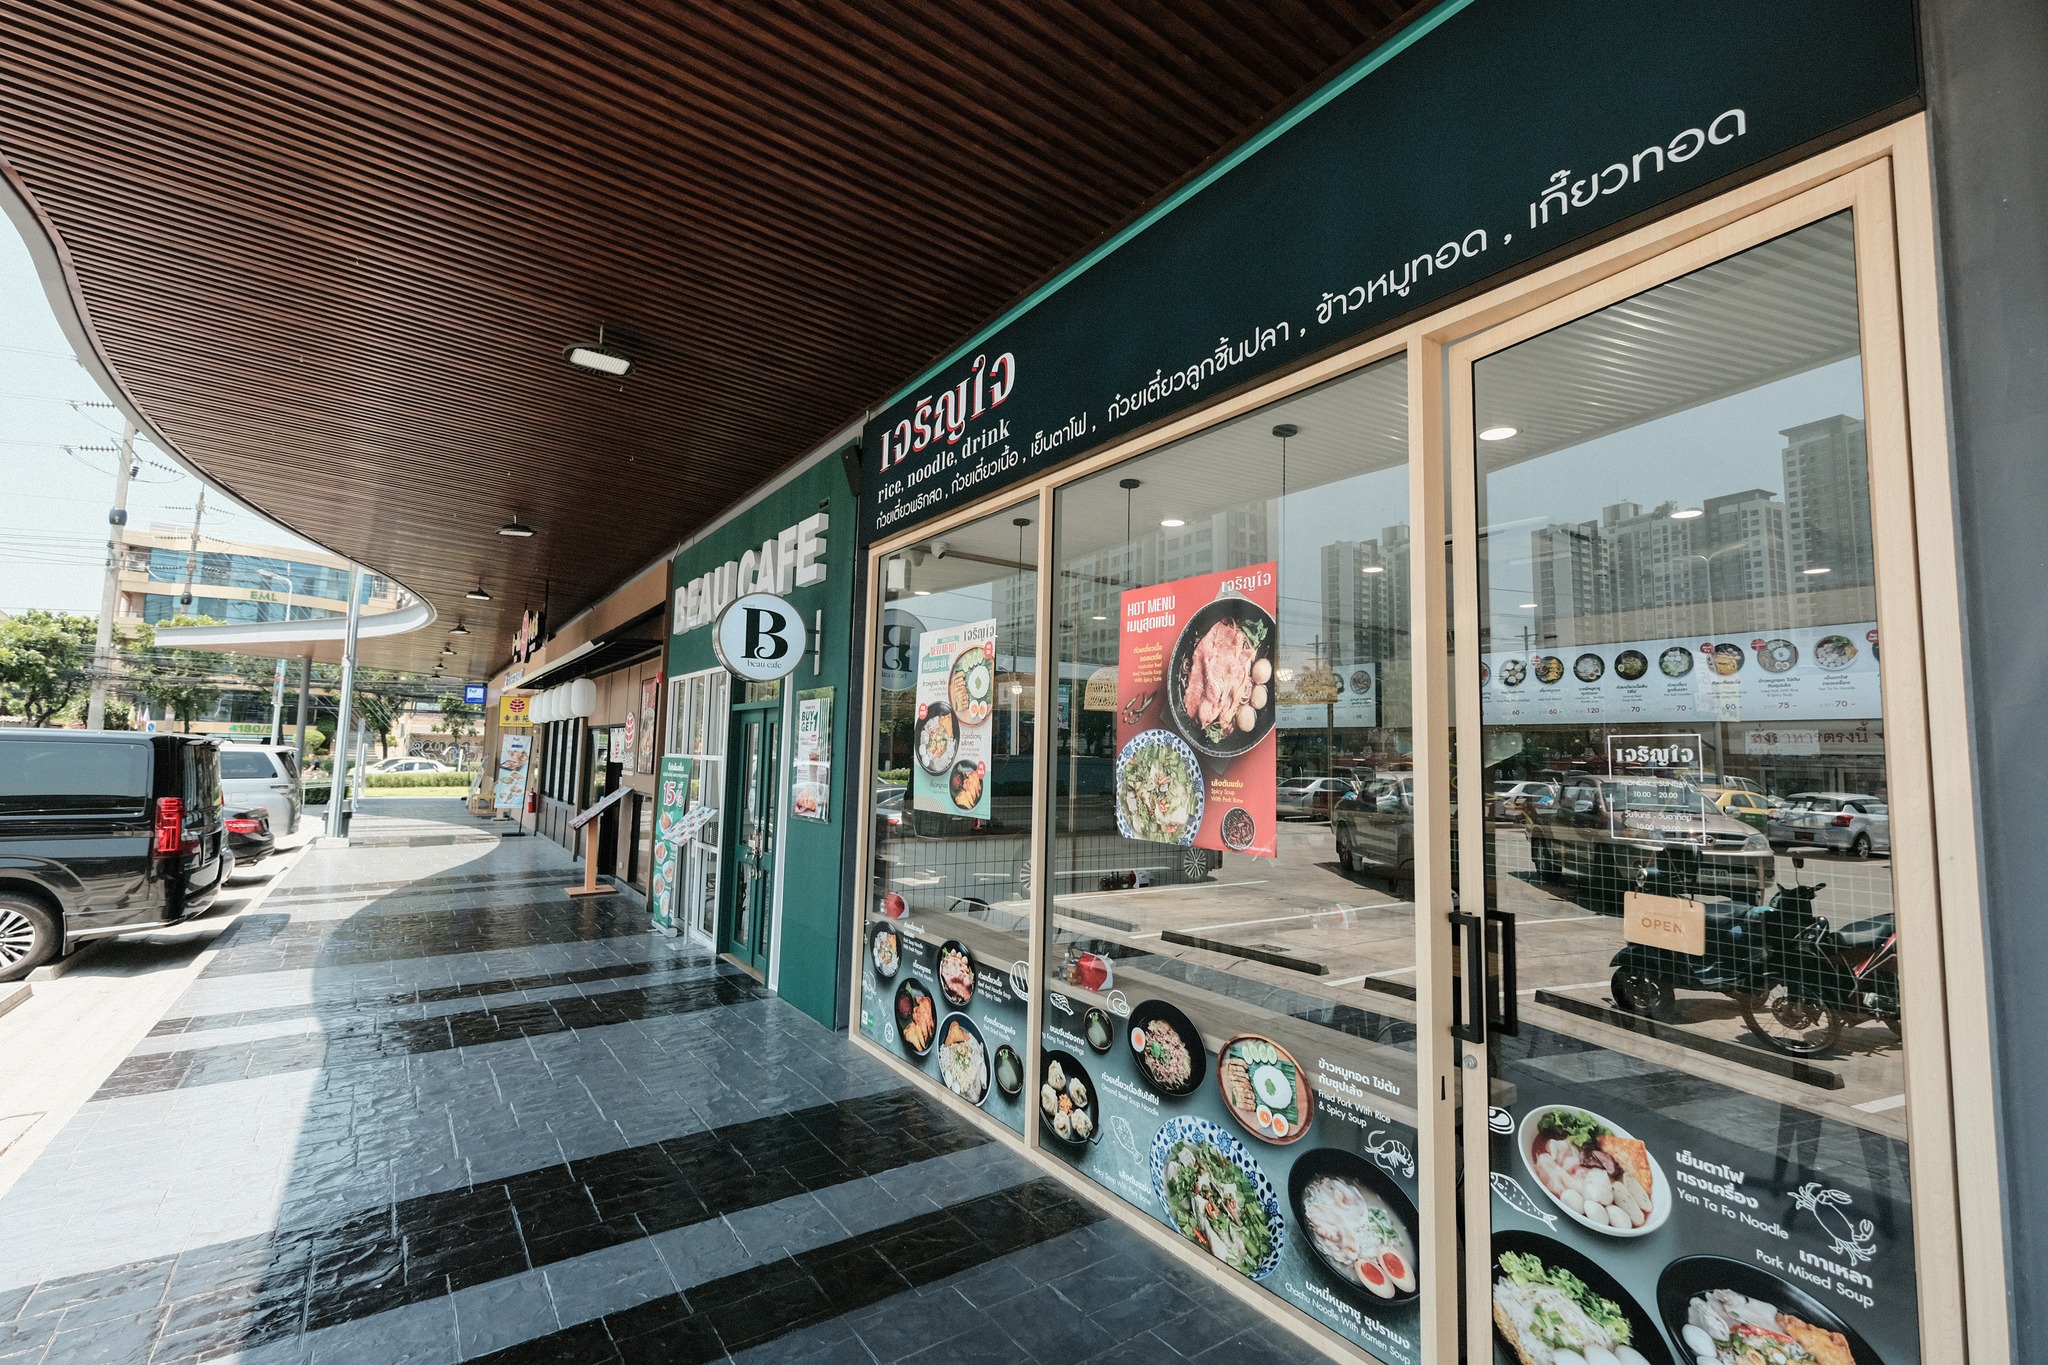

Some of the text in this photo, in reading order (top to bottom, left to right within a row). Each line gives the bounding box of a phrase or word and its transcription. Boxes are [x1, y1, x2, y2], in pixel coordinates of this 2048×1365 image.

[876, 108, 1746, 530] ก๋วยเตี๋ยวพริกสด ก๋วยเตี๋ยวเนื้อ เย็นตาโฟ ก๋วยเตี๋ยวลูกชิ้นปลา ข้าวหมูทอด เกี๊ยวทอด
[879, 352, 1016, 474] เจริญใจ
[877, 418, 1010, 504] rice, noodle, drink
[673, 512, 829, 636] BEAU CAFE
[1221, 571, 1272, 592] เจริญใจ
[250, 590, 278, 602] EML
[1128, 595, 1176, 616] HOT MENU
[740, 608, 788, 660] B
[964, 624, 994, 642] เจริญใจ
[747, 660, 766, 668] beau
[801, 722, 814, 732] GET
[802, 711, 814, 721] BUY
[1616, 744, 1694, 766] เจริญใจ
[664, 781, 676, 806] 15
[1625, 810, 1651, 818] วันจันทร์
[1642, 918, 1682, 934] OPEN
[1318, 1058, 1400, 1095] ข้าวหมูทอด ไข่ต้ม
[1318, 1072, 1363, 1097] กับซุปเล้ง
[1129, 1096, 1140, 1109] Soup
[1141, 1102, 1159, 1117] Noodle
[1318, 1089, 1391, 1124] Fried Pork With Rice
[1318, 1101, 1367, 1129] & Spicy Soup
[1676, 1150, 1745, 1184] เย็นตาโฟ
[1676, 1170, 1759, 1209] ทรงเครื่อง
[1676, 1187, 1789, 1240] Yen Ta Fo Noodle
[1756, 1248, 1874, 1309] Pork Mixed Soup
[1799, 1250, 1873, 1289] เกาเหลา
[1285, 1282, 1411, 1365] Chachu Noodle With Ramen Soup
[1306, 1281, 1410, 1350] บะหมี่หมูชาชู ซุปราเมง
